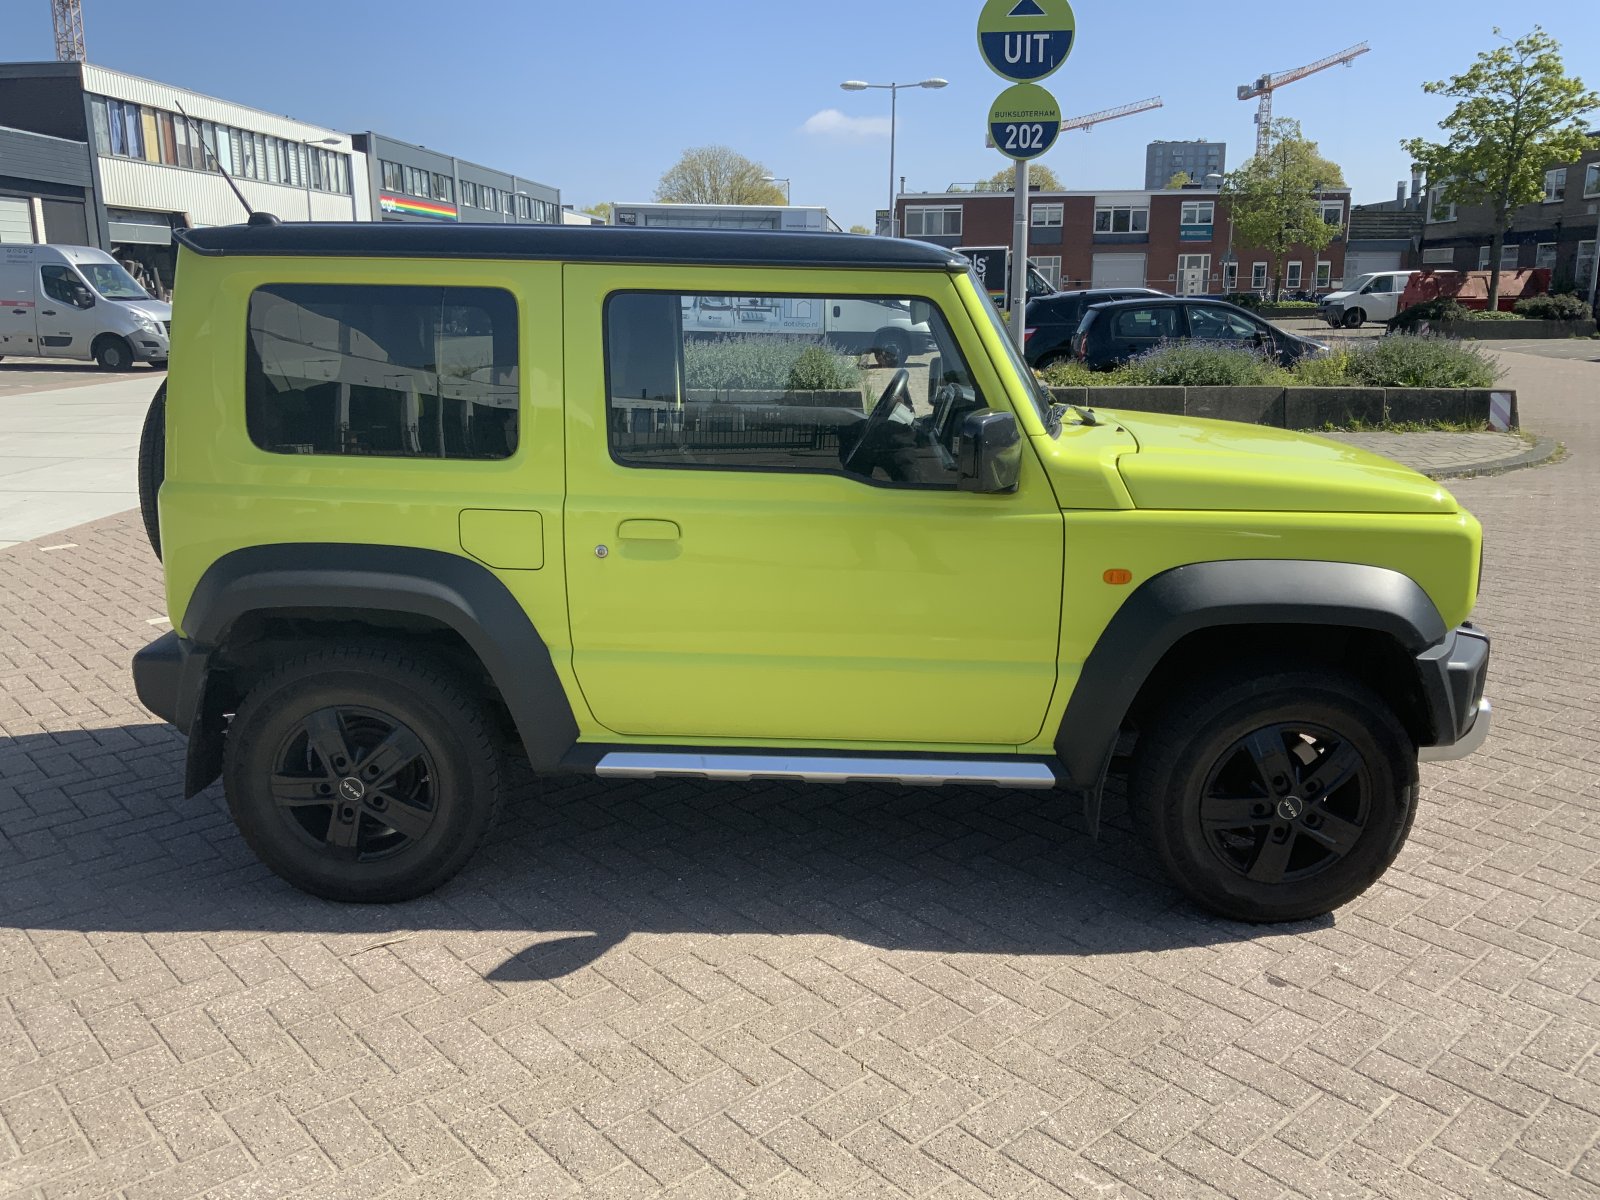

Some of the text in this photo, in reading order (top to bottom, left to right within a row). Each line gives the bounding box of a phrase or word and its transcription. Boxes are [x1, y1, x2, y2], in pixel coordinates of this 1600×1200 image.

[1004, 33, 1050, 63] UIT
[994, 110, 1056, 118] BUIKSLOTERHAM
[1005, 124, 1043, 149] 202
